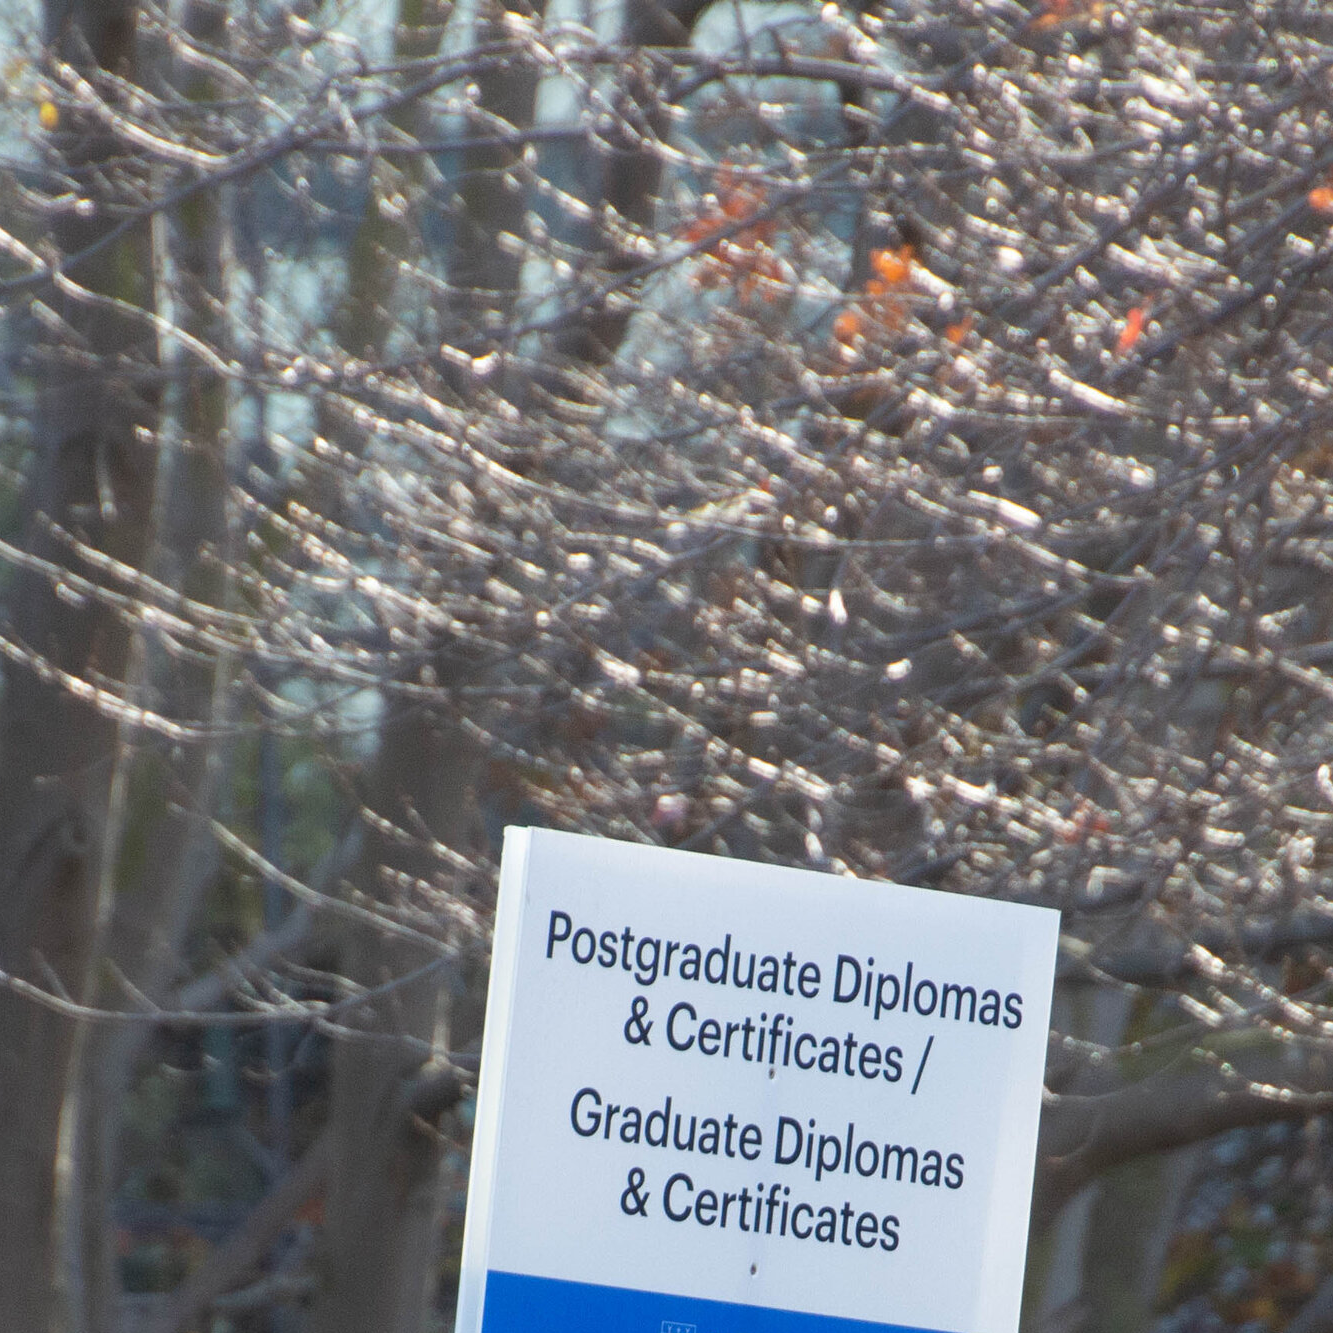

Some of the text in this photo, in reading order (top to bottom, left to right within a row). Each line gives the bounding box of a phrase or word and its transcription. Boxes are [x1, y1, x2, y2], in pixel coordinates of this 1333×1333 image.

[546, 910, 1023, 1030] Postgraduate Diplomas
[623, 995, 935, 1095] & Certificates /
[570, 1087, 965, 1190] Graduate Diplomas
[620, 1167, 900, 1252] & Certificates
